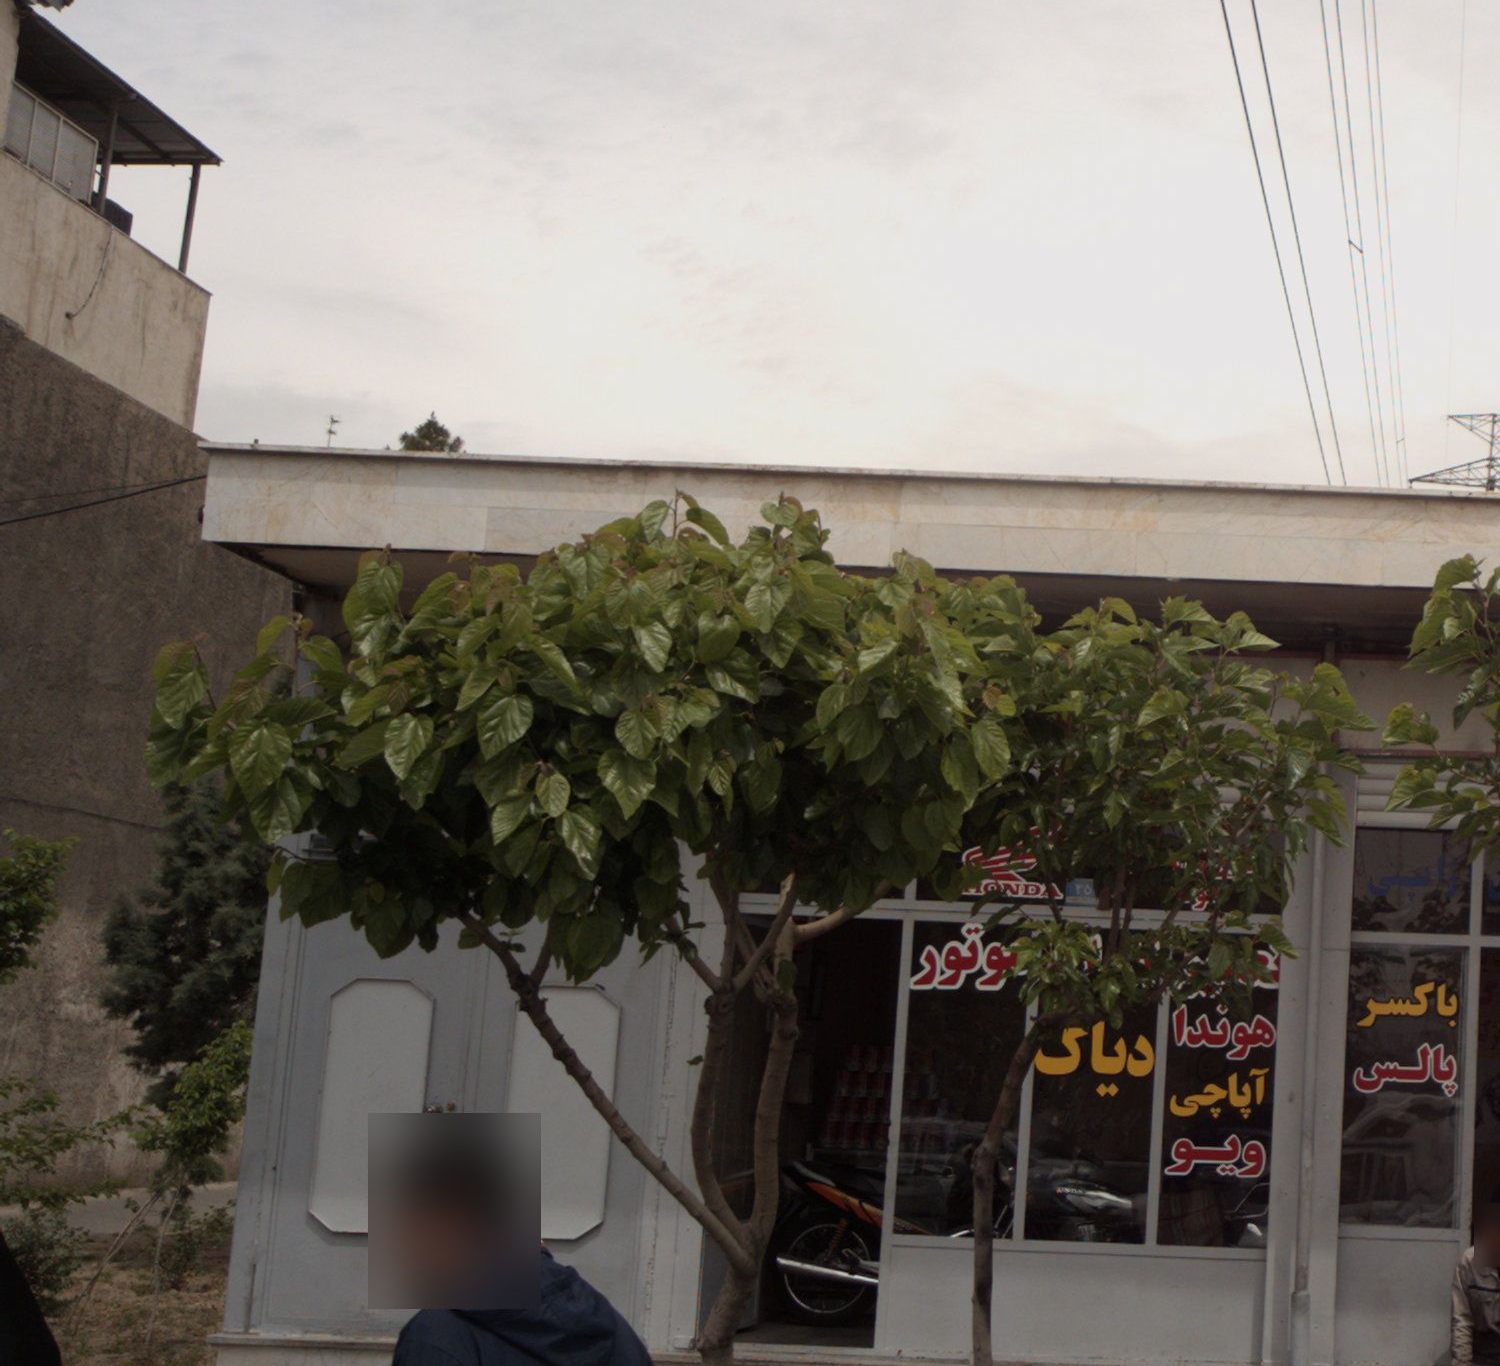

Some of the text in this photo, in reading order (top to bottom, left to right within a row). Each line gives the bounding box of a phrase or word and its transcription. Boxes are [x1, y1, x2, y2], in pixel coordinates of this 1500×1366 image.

[1356, 981, 1458, 1028] باکسر
[1172, 1003, 1276, 1060] هوندا
[1169, 1067, 1270, 1119] آپاچی
[1353, 1042, 1458, 1097] پالس
[1164, 1134, 1267, 1178] ویو
